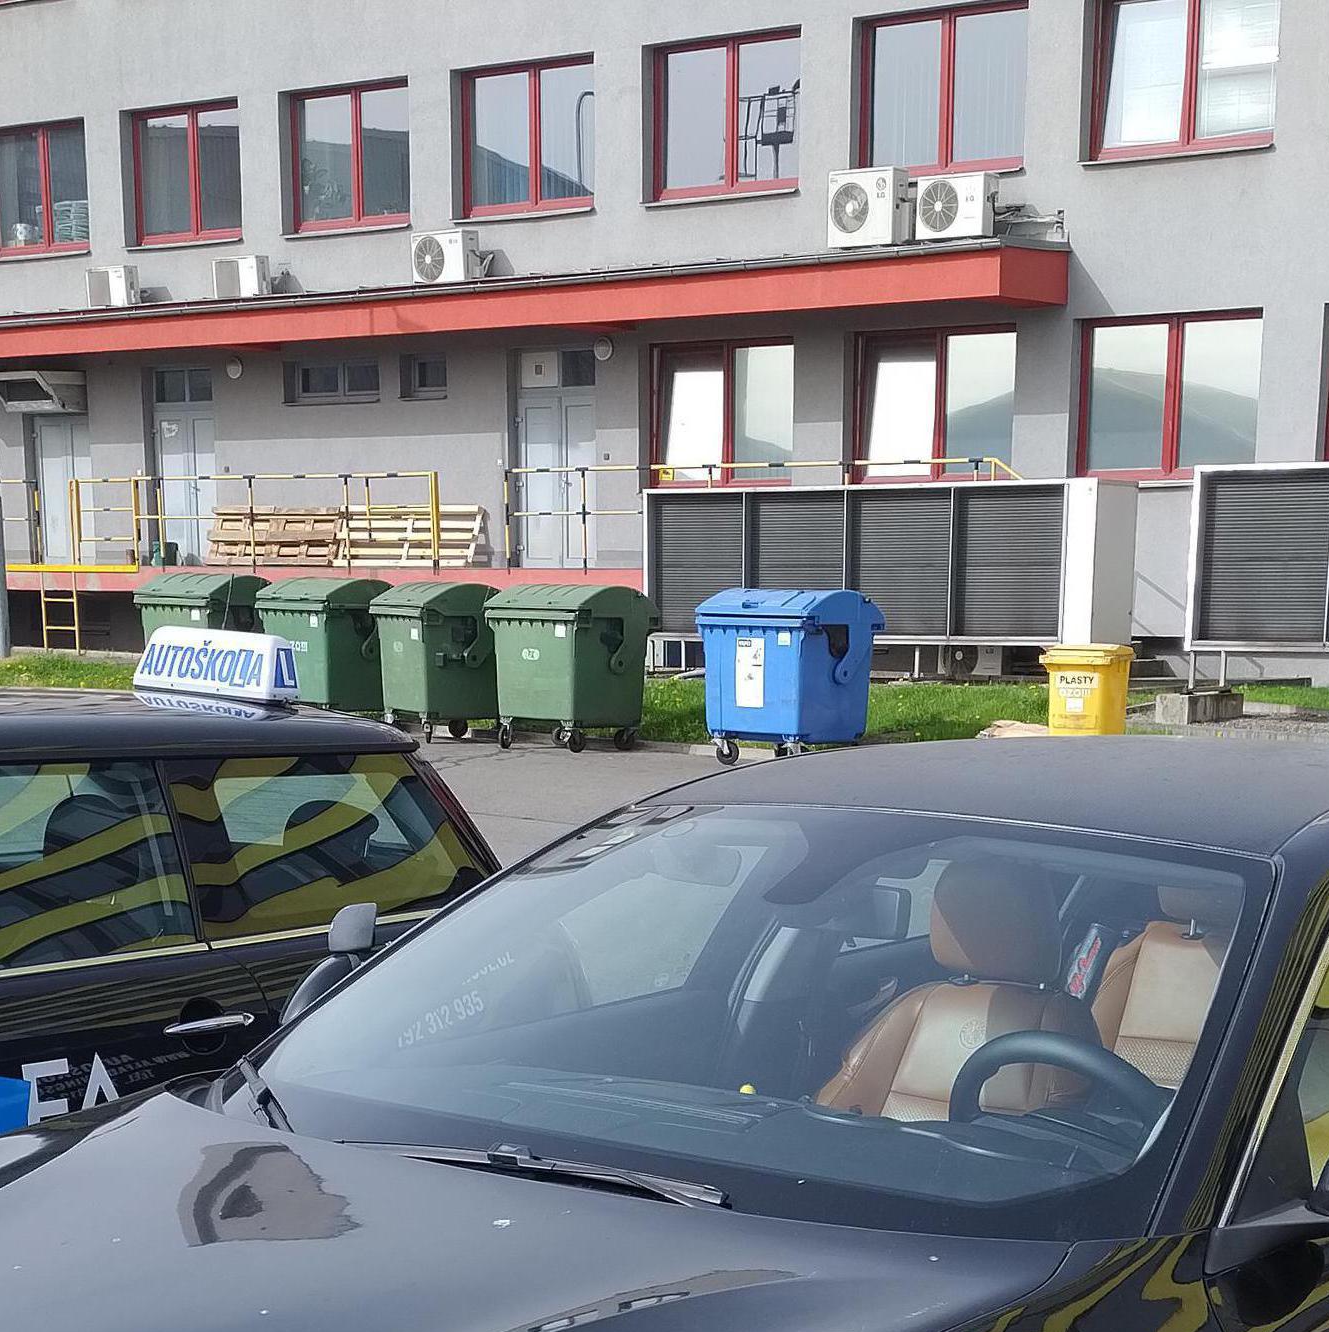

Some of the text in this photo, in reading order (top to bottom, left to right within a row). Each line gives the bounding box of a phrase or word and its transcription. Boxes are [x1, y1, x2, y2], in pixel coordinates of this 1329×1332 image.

[139, 640, 264, 688] AUTOŠKOLA
[1059, 675, 1095, 685] PLASTY
[425, 1004, 454, 1035] 312
[453, 990, 485, 1021] 935
